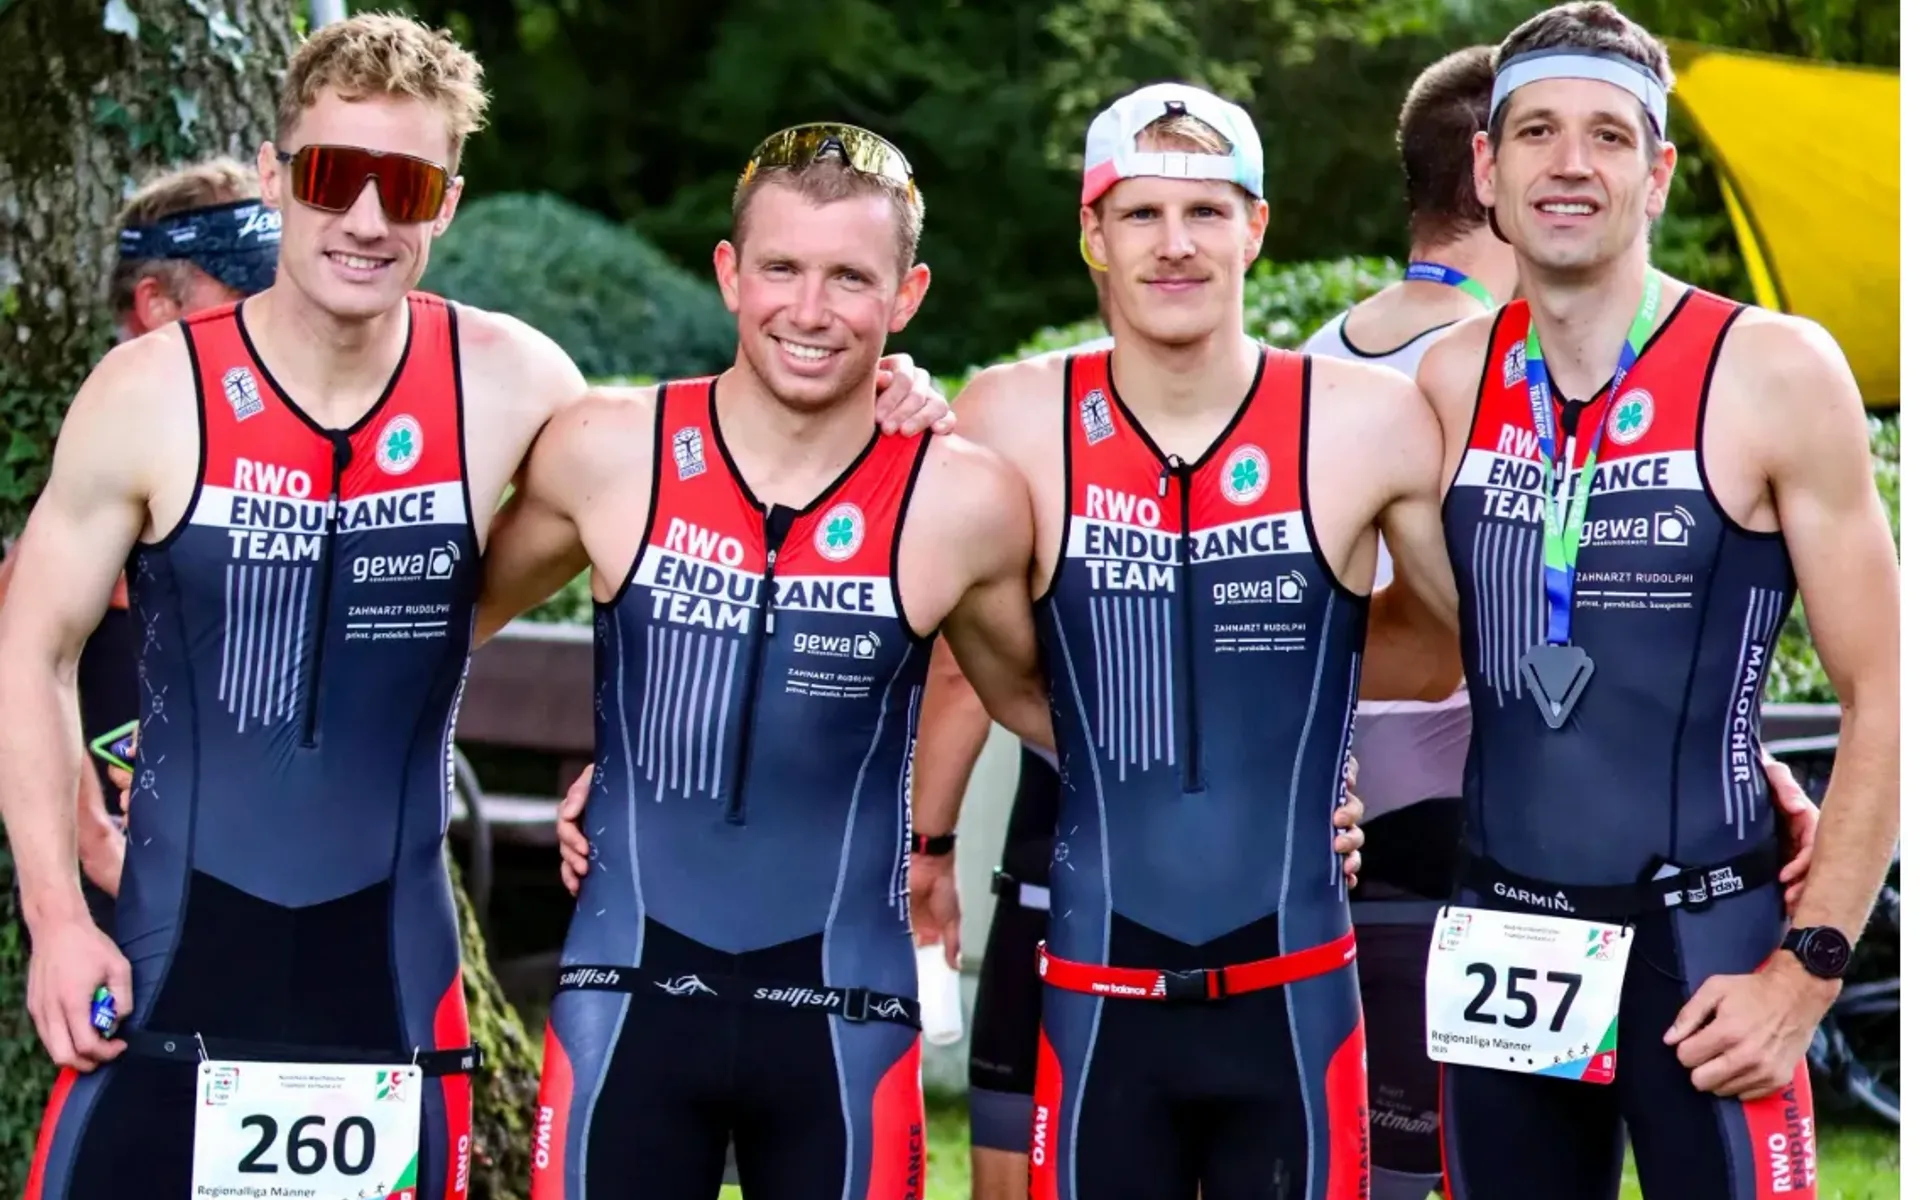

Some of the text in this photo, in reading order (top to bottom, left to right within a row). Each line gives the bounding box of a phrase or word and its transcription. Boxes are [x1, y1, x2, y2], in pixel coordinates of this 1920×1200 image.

[1496, 423, 1543, 460] RW
[234, 457, 312, 499] RWO
[229, 490, 436, 532] ENDURANCE
[1086, 484, 1160, 528] RWO
[228, 529, 322, 562] TEAM
[664, 517, 745, 567] RWO
[1084, 519, 1290, 564] ENDURANCE
[1578, 517, 1649, 547] gewa
[353, 553, 424, 583] gewa
[653, 555, 876, 613] ENDURANCE
[1085, 560, 1176, 593] TEAM
[1576, 572, 1693, 583] ZAHNARZT RUDOLPHI
[348, 605, 403, 616] ZAHNARZT
[650, 590, 750, 635] TEAM
[1213, 580, 1272, 605] gewa
[793, 632, 851, 653] gewa
[1214, 623, 1260, 633] ZAHNARZT
[1732, 645, 1765, 784] MALOCHER
[560, 968, 620, 988] sailfish
[753, 987, 840, 1008] sailfish
[1092, 982, 1147, 996] new balance
[1463, 961, 1583, 1034] 257
[1431, 1030, 1532, 1052] Regionalliga Männer
[237, 1113, 377, 1176] 260
[535, 1105, 554, 1169] RWO
[1032, 1105, 1049, 1166] RWO
[1782, 1082, 1806, 1190] ENDURA
[1801, 1116, 1816, 1187] TEAM
[454, 1134, 469, 1193] RWO
[1768, 1132, 1792, 1193] RWO
[197, 1184, 316, 1198] Regionalliga Männer
